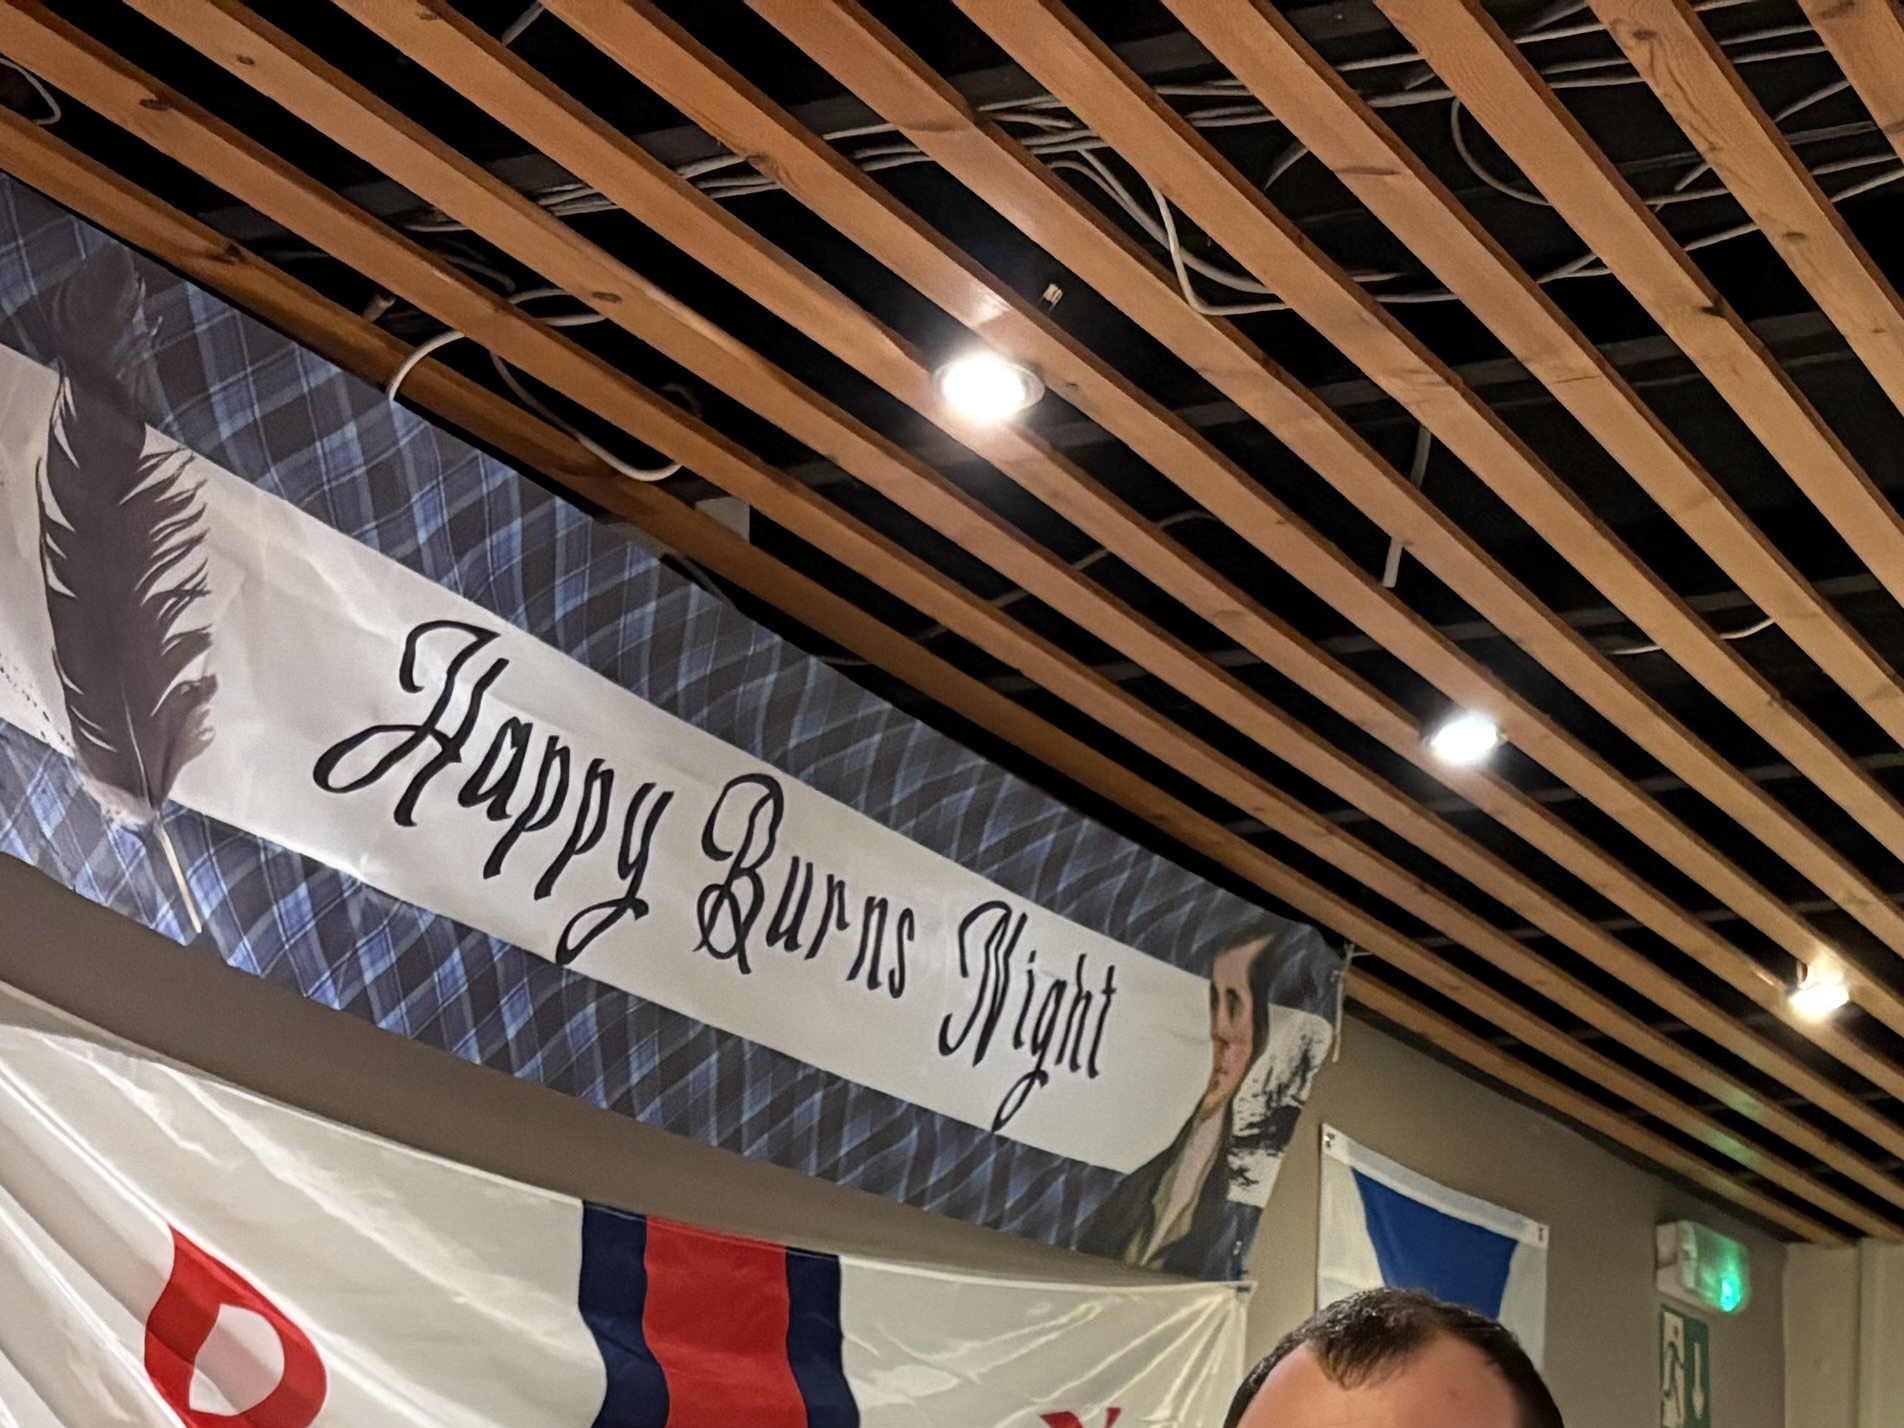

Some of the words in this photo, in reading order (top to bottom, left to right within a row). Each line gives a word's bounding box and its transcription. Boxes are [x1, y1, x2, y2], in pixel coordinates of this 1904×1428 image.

[312, 618, 673, 962] Happy
[692, 772, 917, 999] Burns
[937, 900, 1118, 1132] Night
